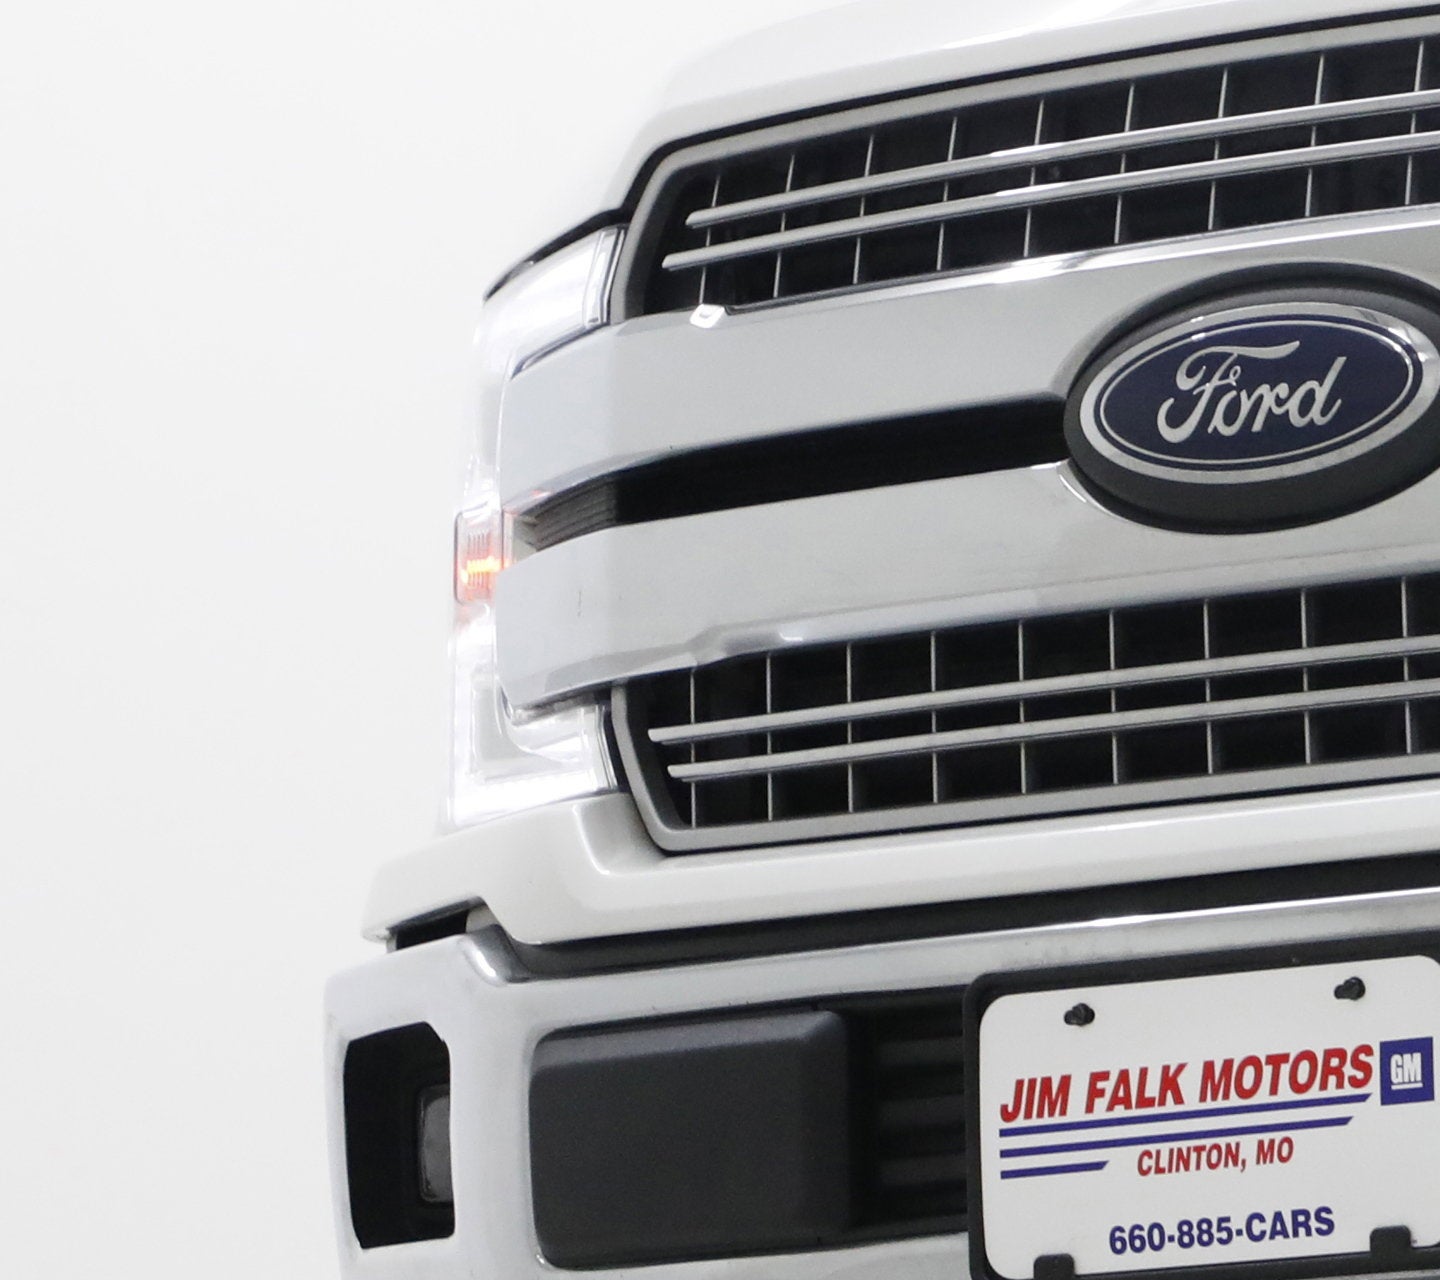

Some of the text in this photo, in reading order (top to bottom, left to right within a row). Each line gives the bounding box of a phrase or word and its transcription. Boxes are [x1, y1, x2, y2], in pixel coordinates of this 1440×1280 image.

[1156, 339, 1347, 444] Ford
[1000, 1044, 1375, 1123] JIM FALK MOTORS
[1390, 1052, 1423, 1090] GM
[1137, 1136, 1295, 1177] CLINTON, MO
[1109, 1206, 1335, 1255] 660-885-CARS
